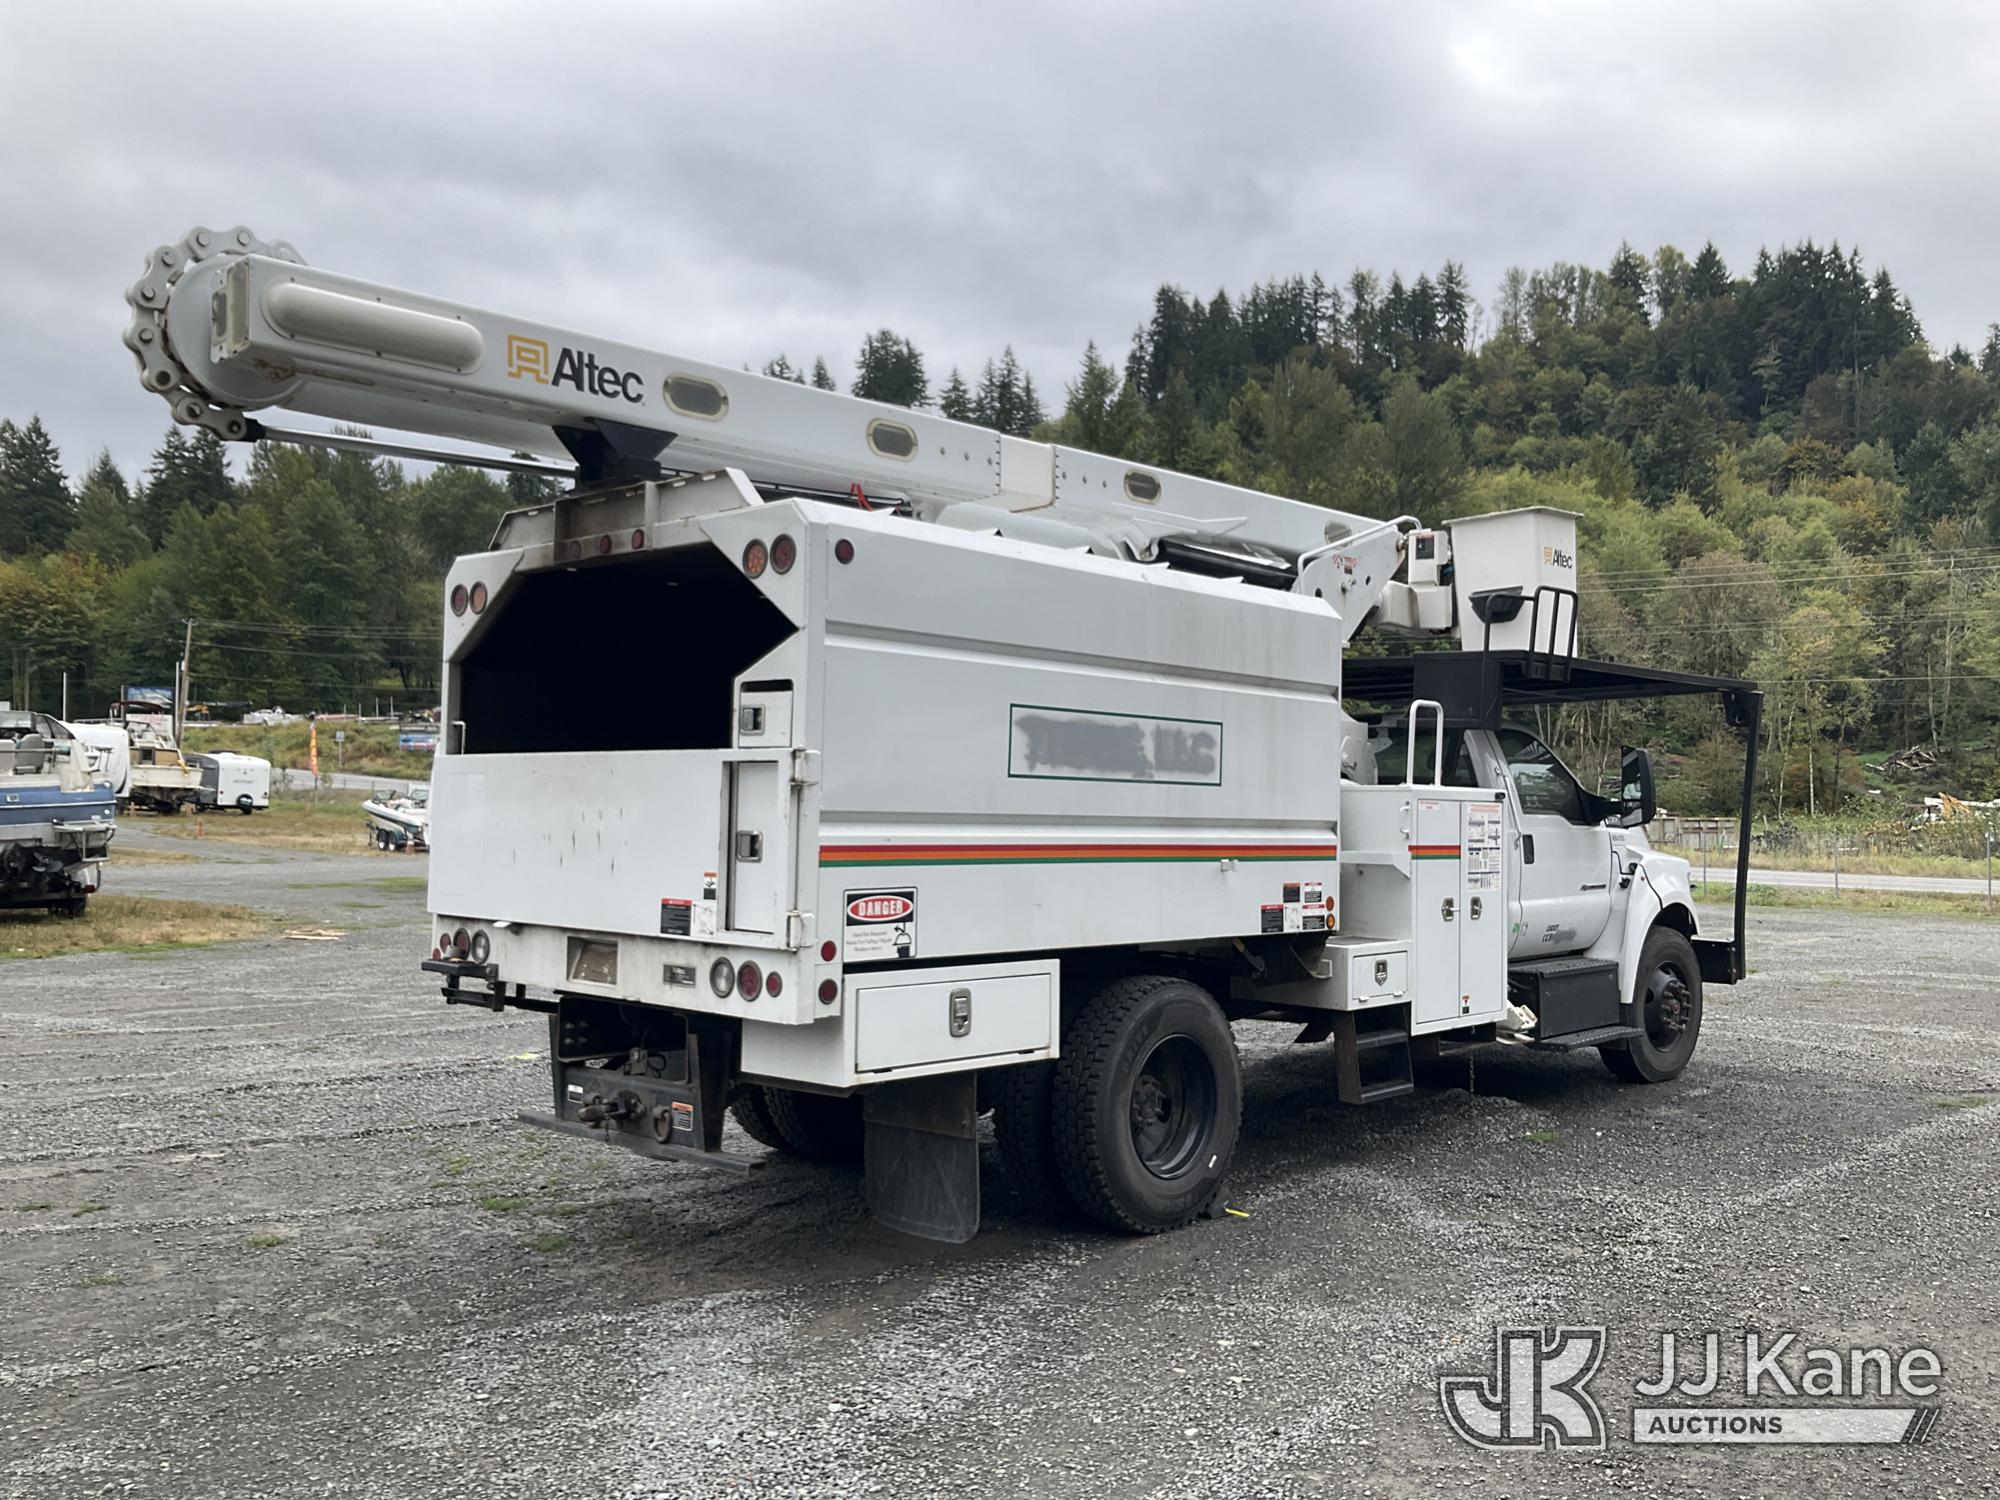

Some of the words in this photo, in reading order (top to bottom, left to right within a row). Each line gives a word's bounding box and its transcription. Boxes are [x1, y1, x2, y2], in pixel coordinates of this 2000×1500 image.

[551, 346, 644, 404] Altec
[1552, 549, 1573, 569] Altec
[858, 899, 904, 917] DANGER
